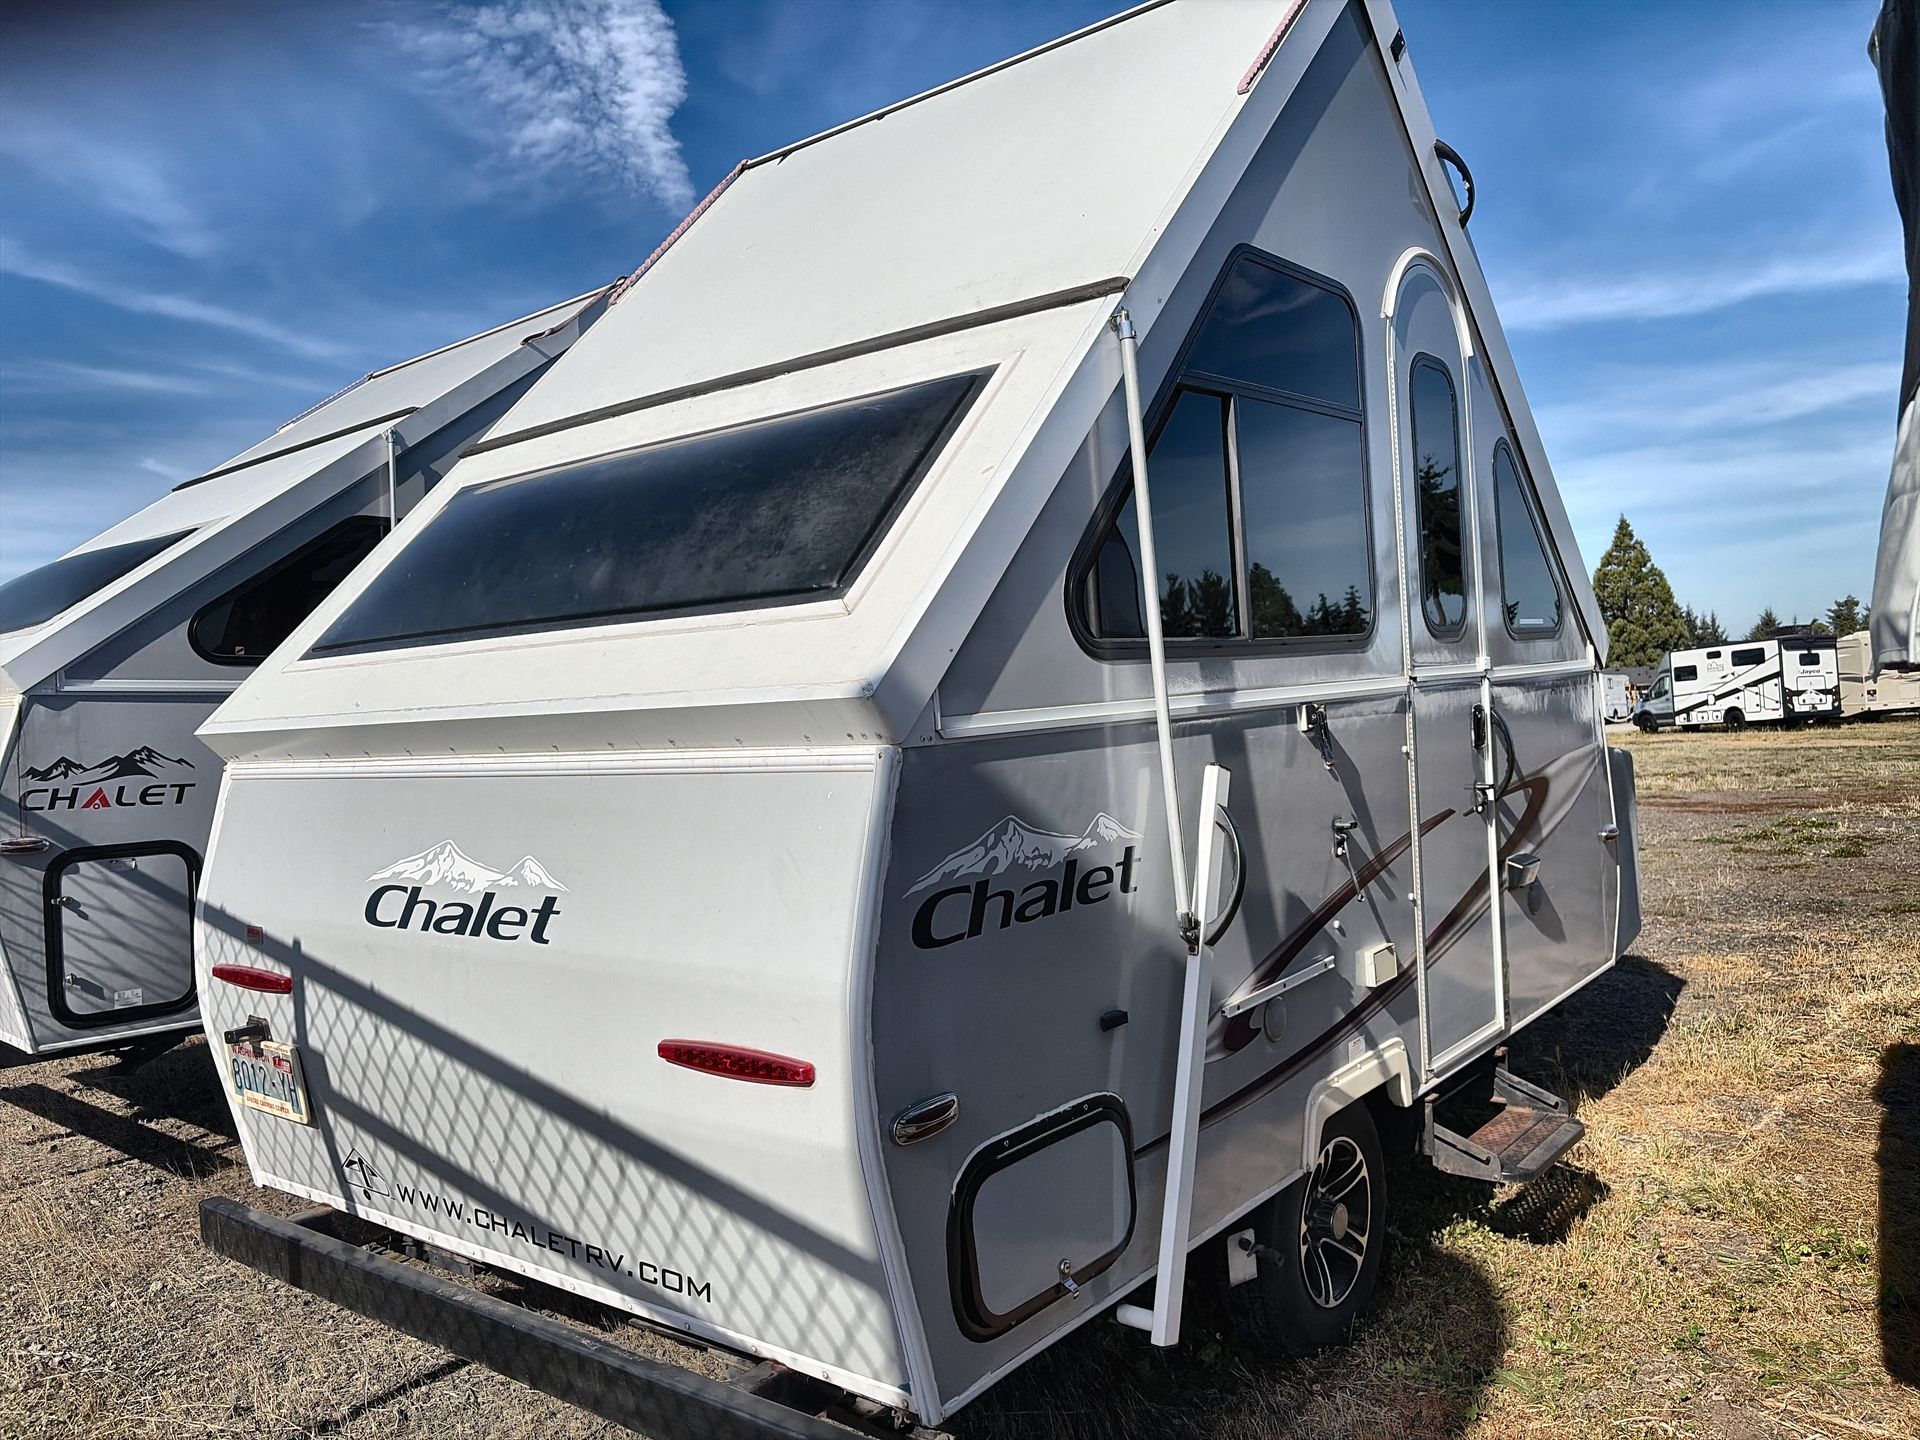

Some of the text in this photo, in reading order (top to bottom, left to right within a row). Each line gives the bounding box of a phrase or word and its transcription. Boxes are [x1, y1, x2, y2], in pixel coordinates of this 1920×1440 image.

[20, 783, 196, 812] CHALET
[364, 884, 561, 945] Chalet
[911, 845, 1142, 950] Chalet
[396, 1183, 713, 1304] WWW.CHALETRV.COM
